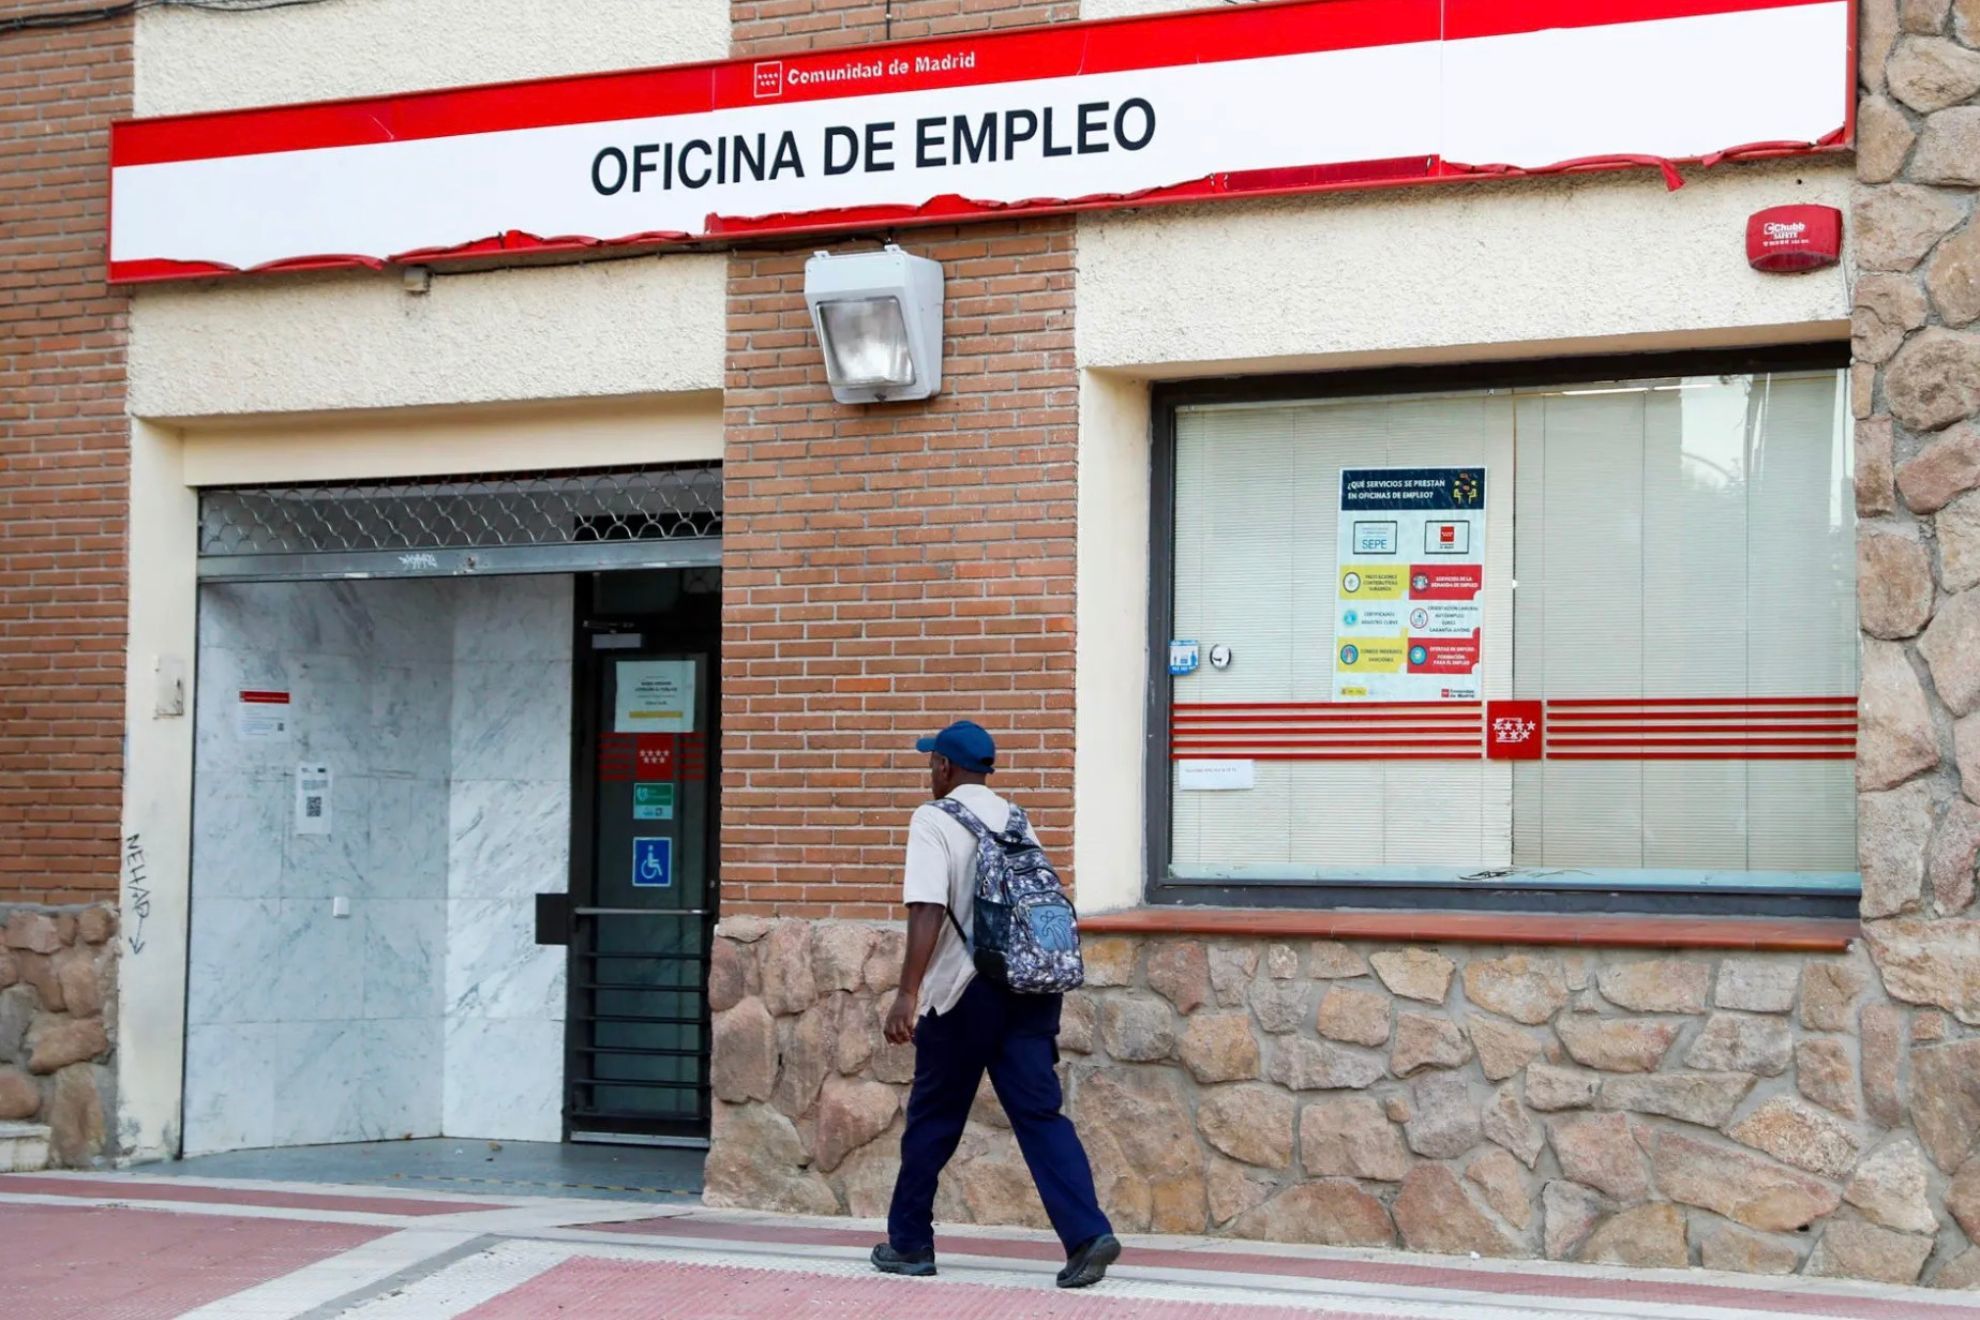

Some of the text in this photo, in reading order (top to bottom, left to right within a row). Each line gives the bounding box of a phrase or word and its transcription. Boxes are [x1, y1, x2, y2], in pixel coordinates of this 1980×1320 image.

[788, 52, 976, 84] Comunidad de Madrid
[591, 97, 1157, 196] OFICINA DE EMPLEO
[1774, 222, 1806, 233] Chubb
[1366, 480, 1402, 488] SERVICIOS
[1414, 479, 1446, 487] PRESTAN
[1402, 491, 1434, 499] EMPLEO?
[1362, 539, 1387, 549] SEPE
